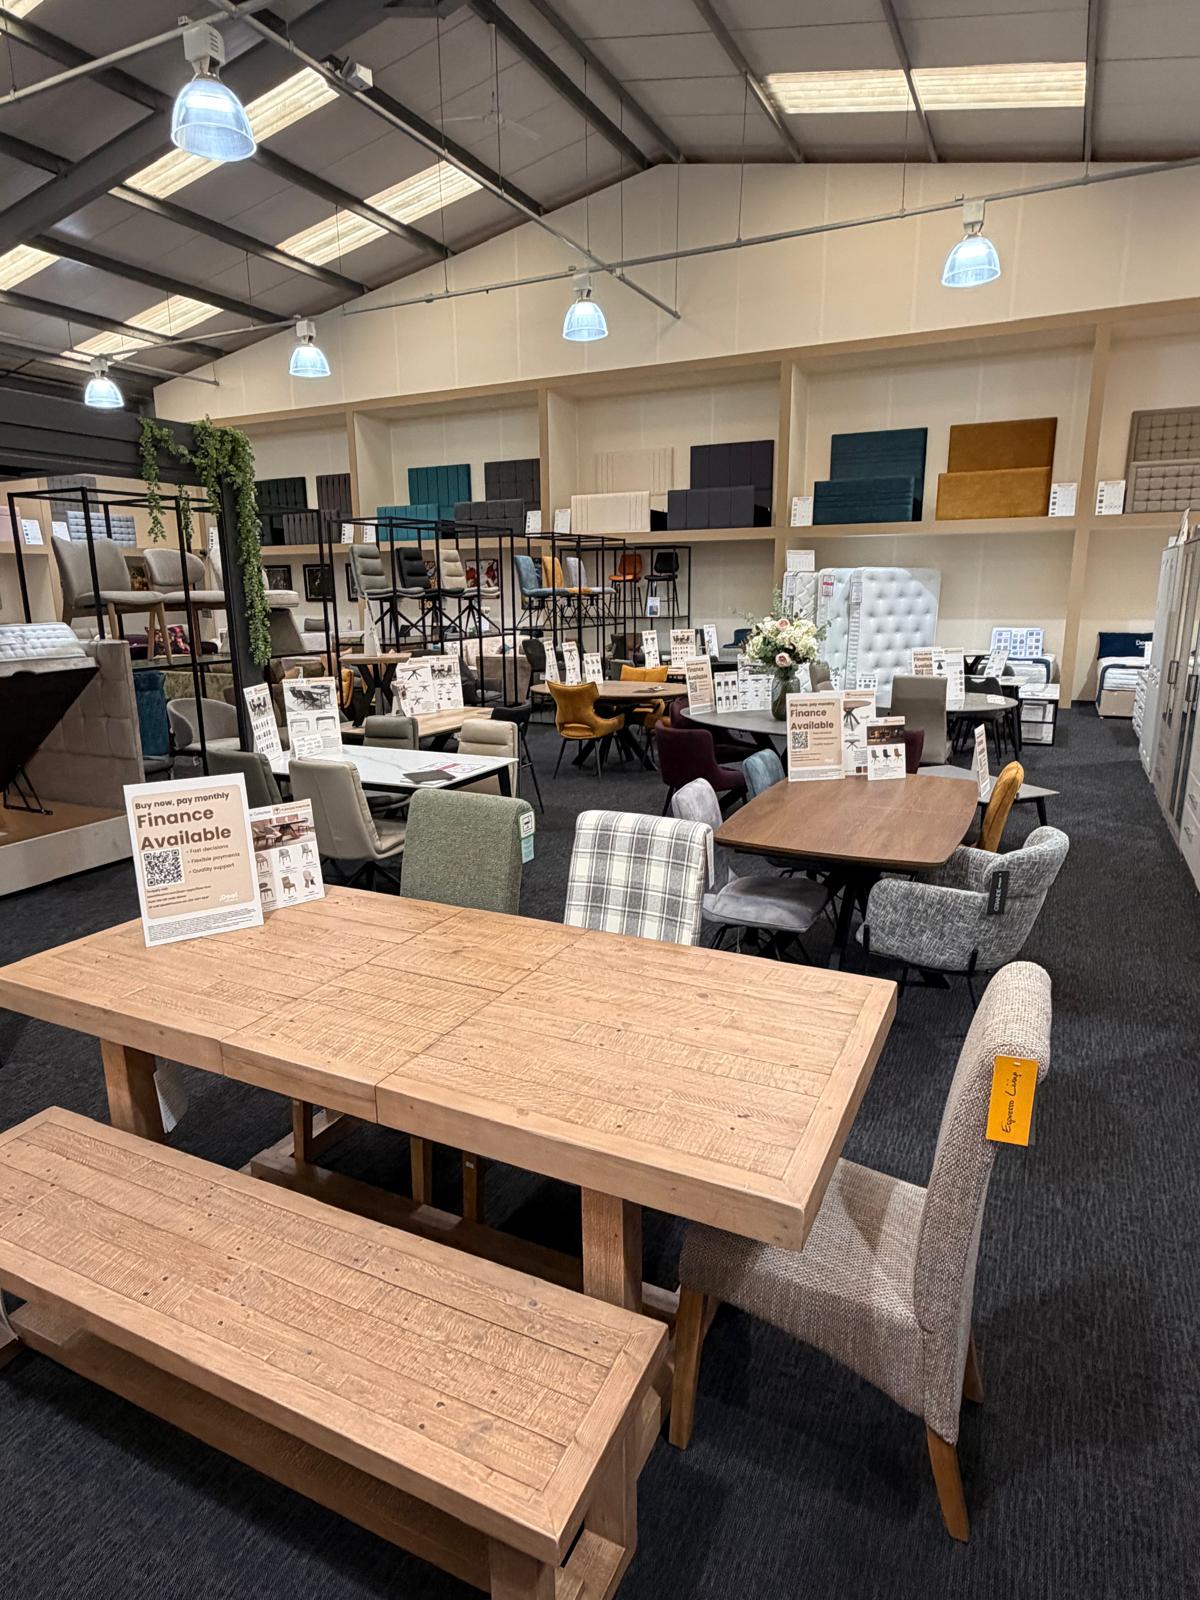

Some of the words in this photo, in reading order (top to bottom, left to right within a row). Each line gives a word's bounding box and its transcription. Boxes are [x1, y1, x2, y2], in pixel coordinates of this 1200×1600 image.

[790, 708, 827, 717] Finance
[791, 720, 834, 730] Available
[135, 802, 152, 811] Buy
[154, 799, 175, 808] now,
[176, 796, 193, 807] pay
[194, 791, 230, 802] monthly
[137, 808, 214, 829] Finance
[141, 826, 231, 851] Available
